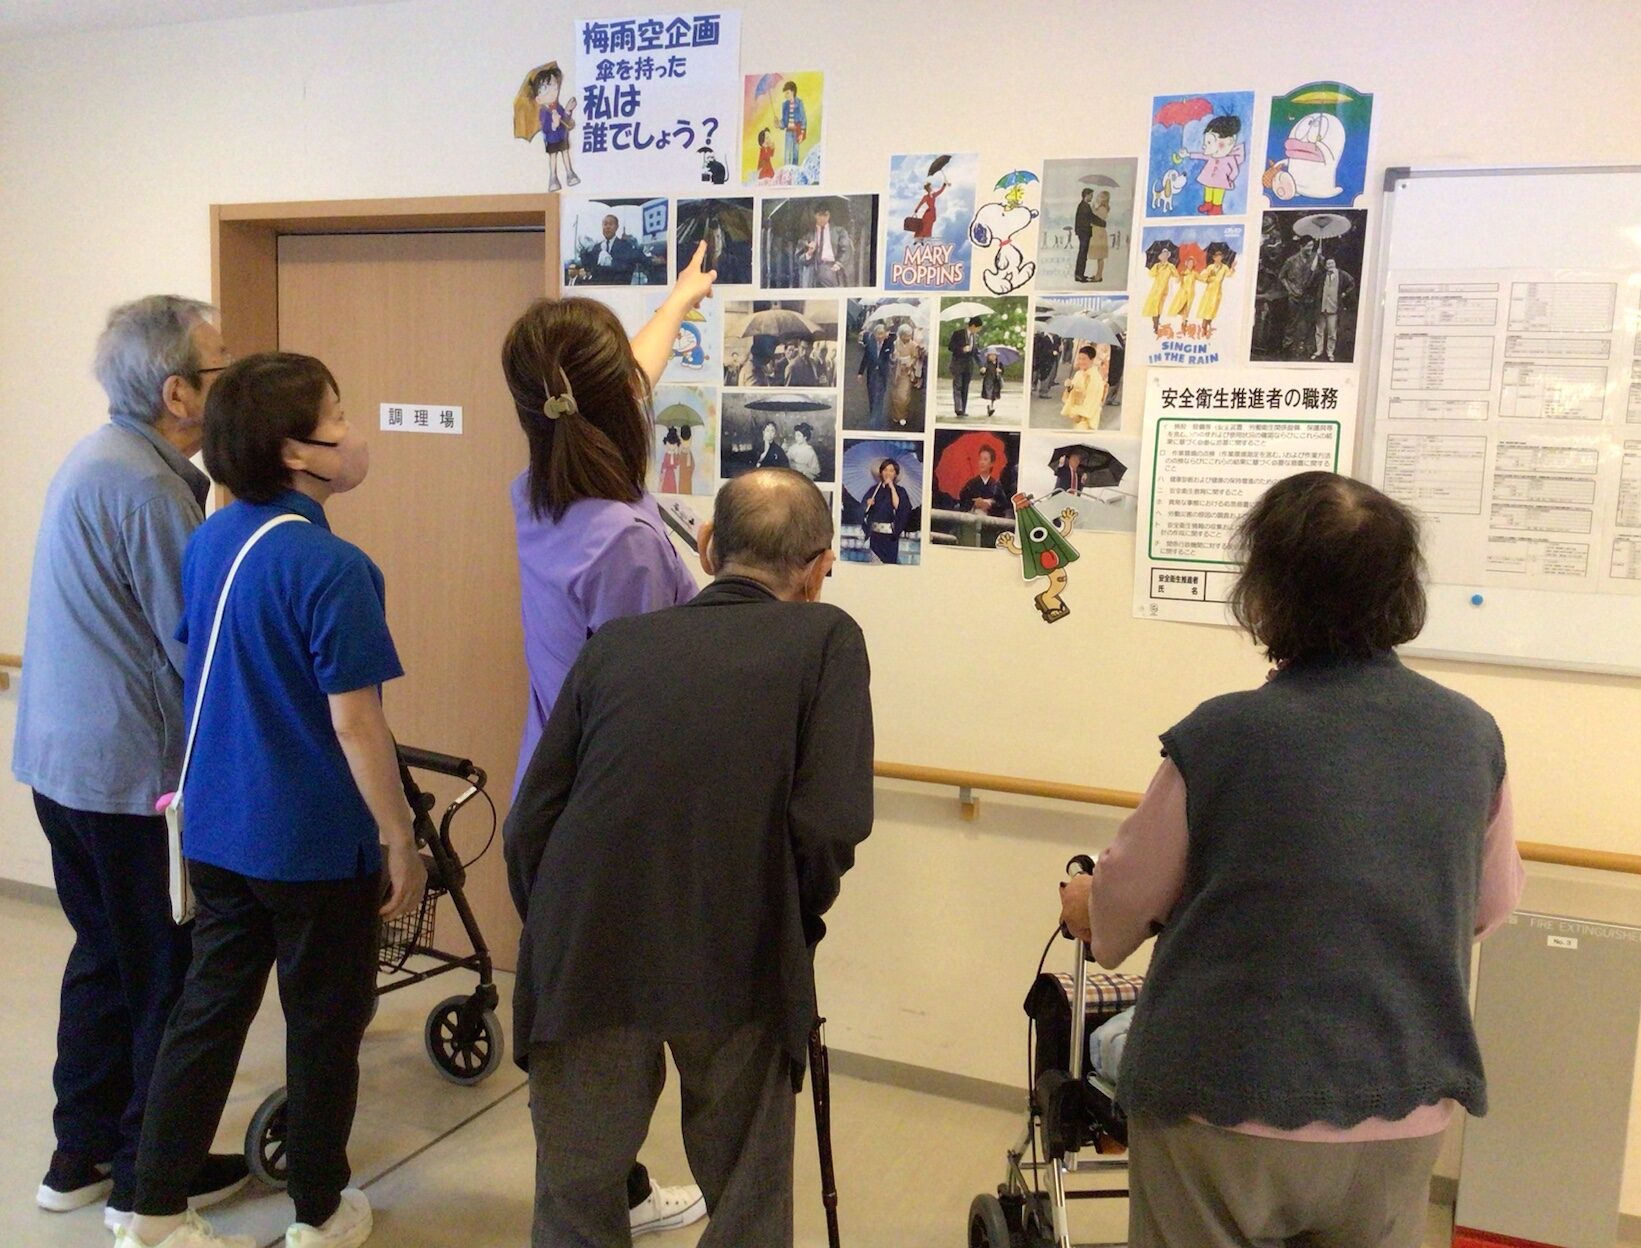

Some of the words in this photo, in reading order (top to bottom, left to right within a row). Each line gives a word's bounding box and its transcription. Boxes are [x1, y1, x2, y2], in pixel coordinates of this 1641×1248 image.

[583, 14, 721, 55] 梅雨空企画
[595, 55, 687, 82] 傘を持った
[583, 84, 641, 120] 私は
[904, 243, 953, 266] MARY
[892, 262, 963, 286] POPPINS
[1149, 353, 1162, 364] IN
[1164, 352, 1186, 363] THE
[1188, 353, 1219, 365] RAIN
[1161, 387, 1338, 410] 安全衛生推進者の職務
[388, 407, 455, 429] 調理場
[1529, 917, 1553, 930] FIRE
